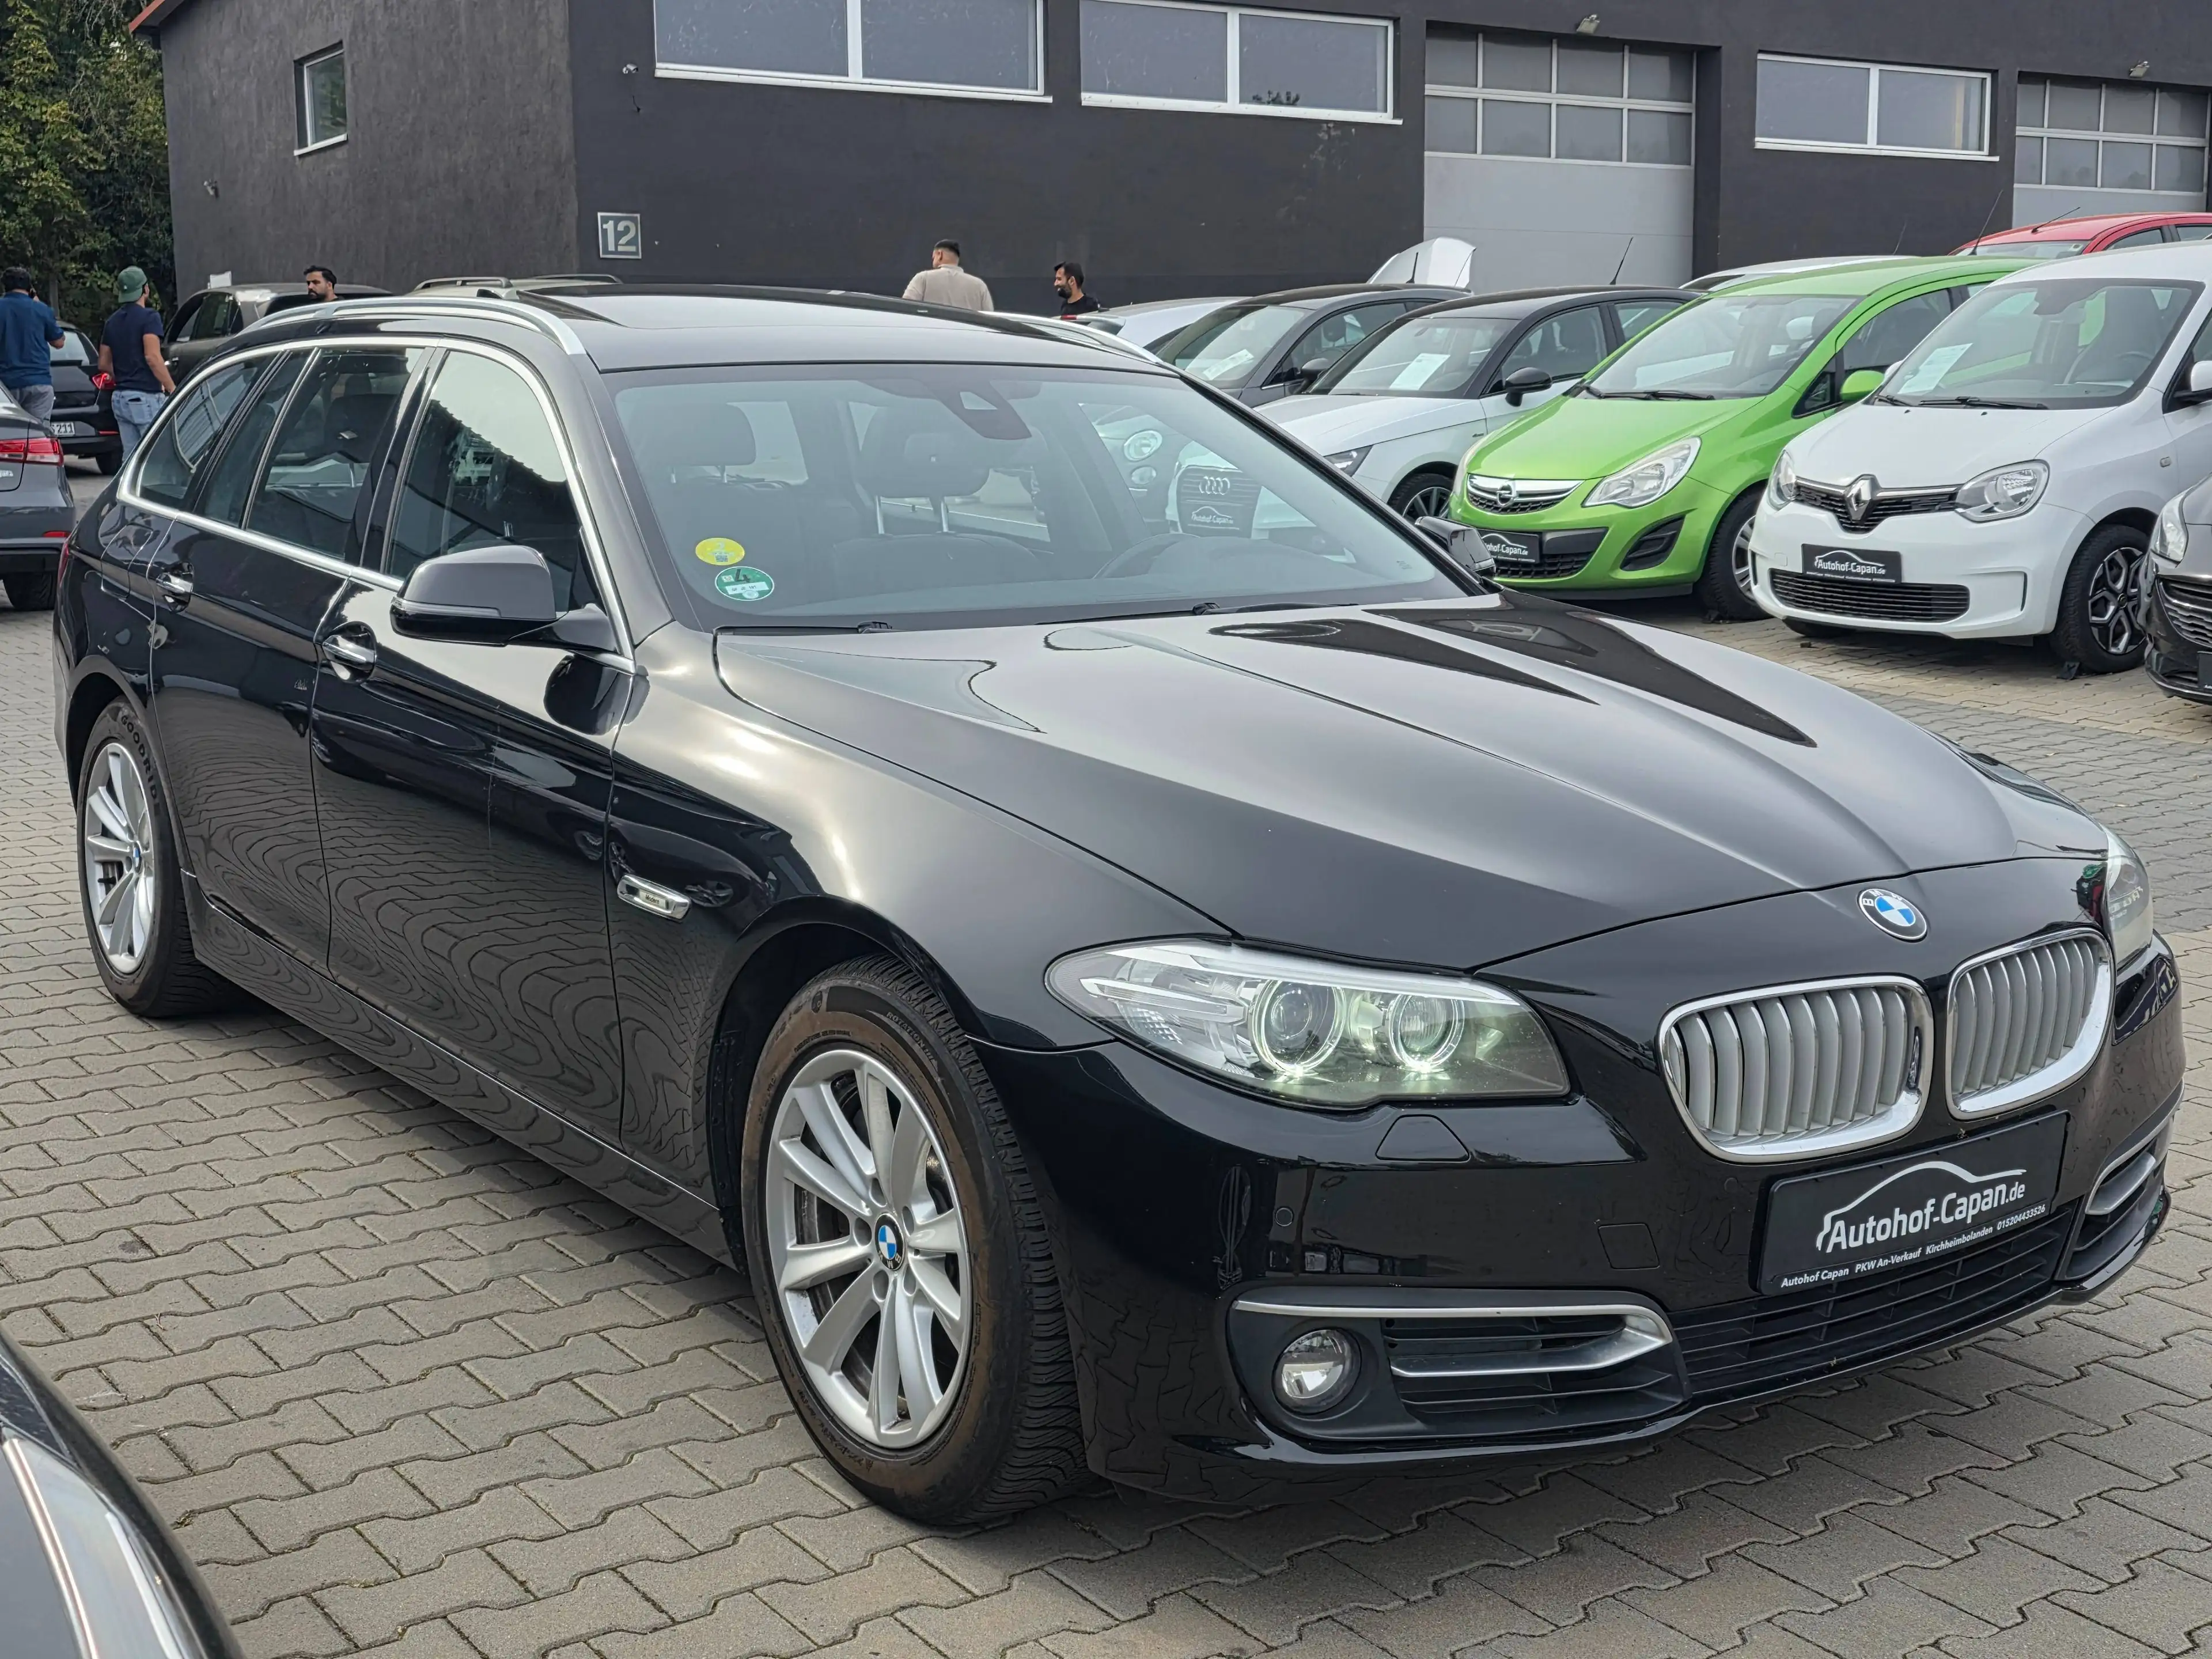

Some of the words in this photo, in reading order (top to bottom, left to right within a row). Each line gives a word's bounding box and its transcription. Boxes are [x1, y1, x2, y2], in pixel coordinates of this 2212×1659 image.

[602, 220, 637, 252] 12
[1817, 559, 1887, 575] Autohof-Capan.de
[886, 1011, 926, 1048] ROTATION
[1825, 1181, 2026, 1253] Autohof-Capan.de
[878, 1250, 902, 1269] BMW
[1781, 1271, 1820, 1288] Autohof
[1821, 1267, 1850, 1281] Capan
[1855, 1260, 1877, 1273] PKW
[1876, 1247, 1922, 1268] An-Verkauf
[1925, 1225, 1994, 1255] Kirchheimbolanden
[1997, 1204, 2046, 1230] 015204433526
